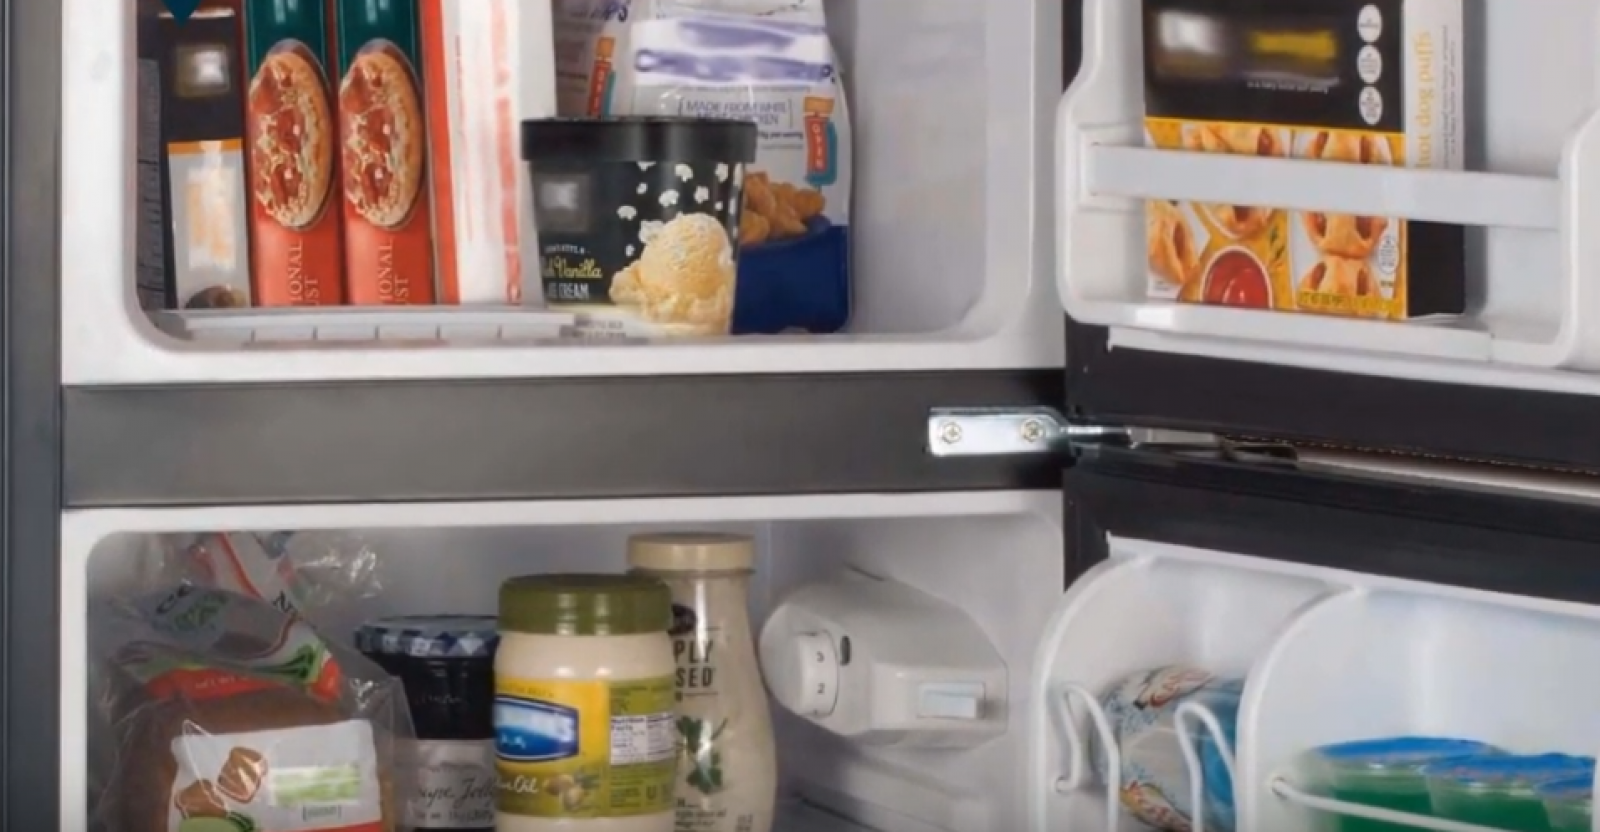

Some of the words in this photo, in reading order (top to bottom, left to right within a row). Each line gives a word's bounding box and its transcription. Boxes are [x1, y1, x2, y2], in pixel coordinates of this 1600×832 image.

[1413, 30, 1433, 83] puffs
[1415, 88, 1434, 127] dog
[553, 256, 603, 279] Vanilla
[815, 650, 826, 664] 3
[674, 666, 714, 689] SED
